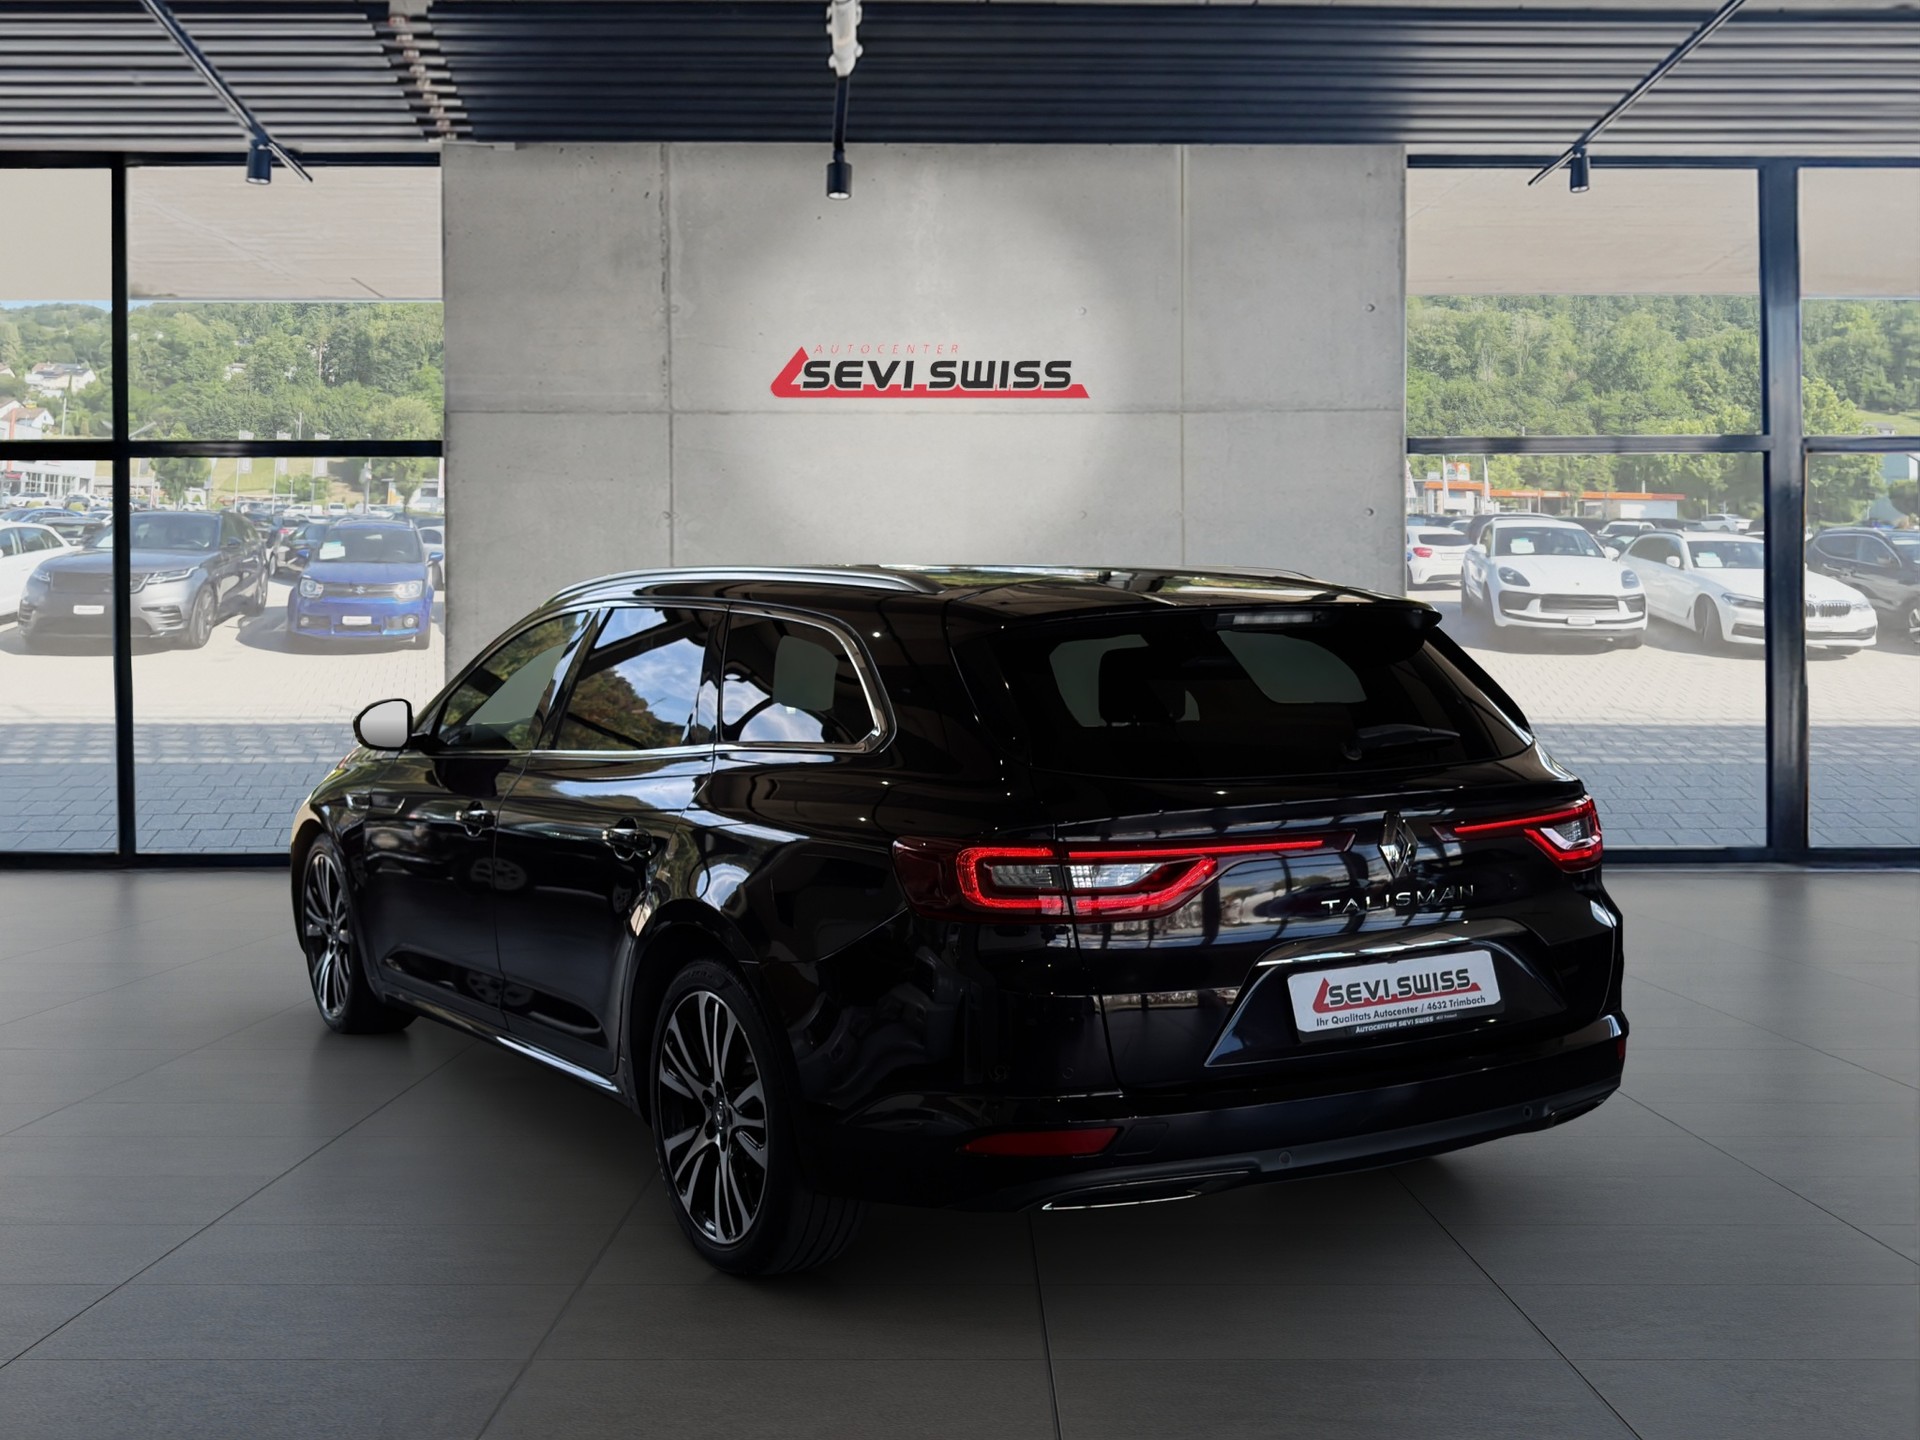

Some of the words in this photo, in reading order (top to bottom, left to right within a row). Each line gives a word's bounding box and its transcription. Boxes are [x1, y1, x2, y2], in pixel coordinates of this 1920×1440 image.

[813, 343, 960, 354] AUTOCENTER
[802, 360, 914, 389] SEVI
[928, 360, 1072, 389] SWISS
[1320, 884, 1474, 915] TALISMAN
[1328, 979, 1390, 1006] SEVI
[1397, 968, 1471, 996] SWISS
[1316, 1017, 1329, 1027] Ihr
[1373, 1005, 1418, 1019] Autocenter
[1427, 1001, 1447, 1011] 4632
[1449, 995, 1486, 1008] Trimbach
[1398, 1018, 1414, 1027] SEVI
[1415, 1016, 1434, 1025] SWISS
